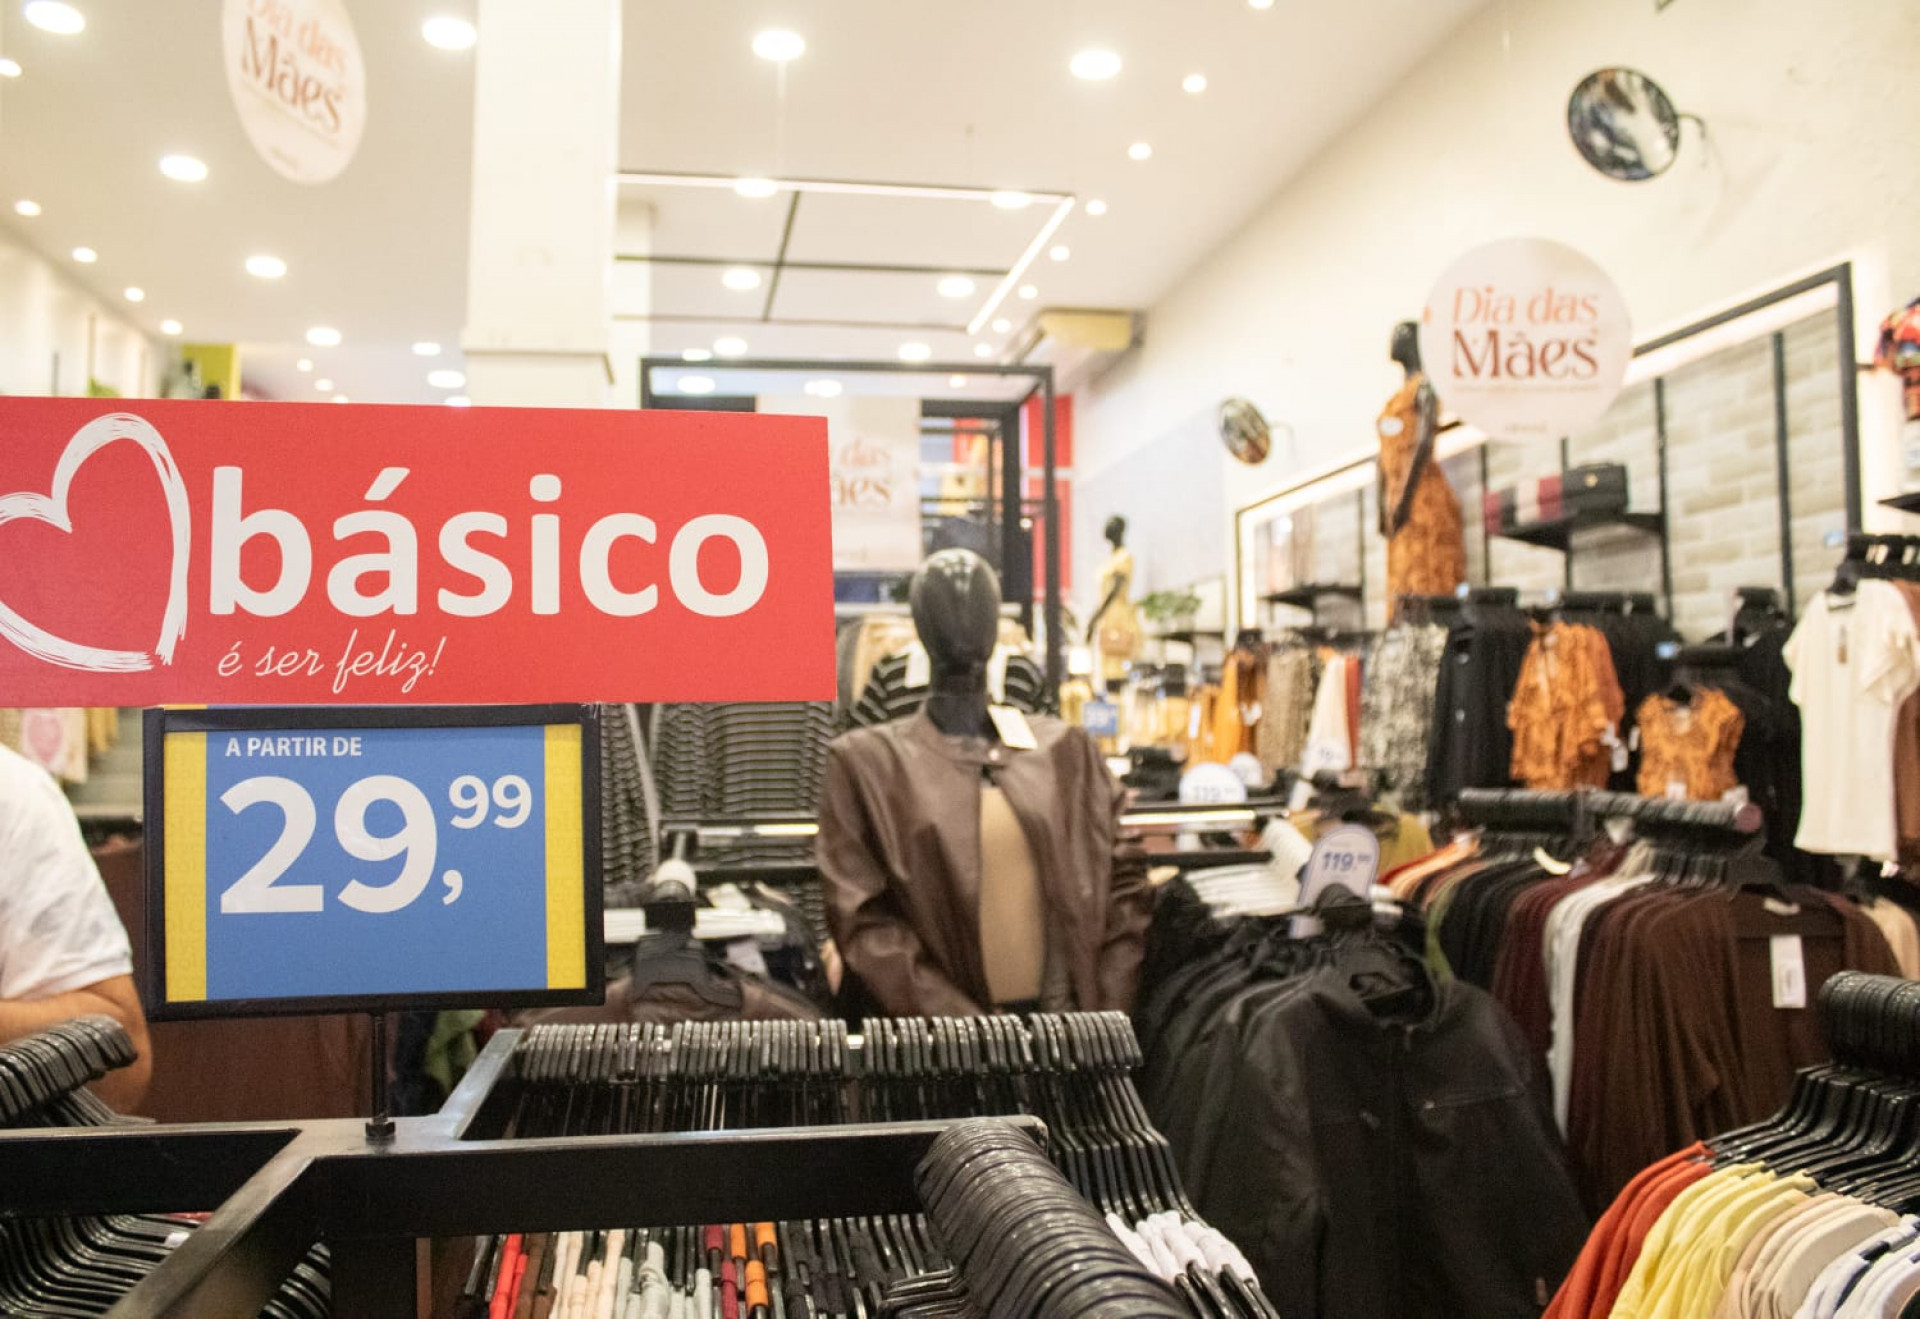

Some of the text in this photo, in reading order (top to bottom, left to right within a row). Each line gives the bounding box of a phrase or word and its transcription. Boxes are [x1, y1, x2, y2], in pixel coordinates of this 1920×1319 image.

[1453, 286, 1599, 324] Dia das
[1452, 329, 1599, 379] Mães
[210, 466, 769, 617] básico
[217, 629, 444, 694] é ser feliz!
[225, 737, 363, 757] A PARTIR DE
[219, 774, 532, 914] 29,99
